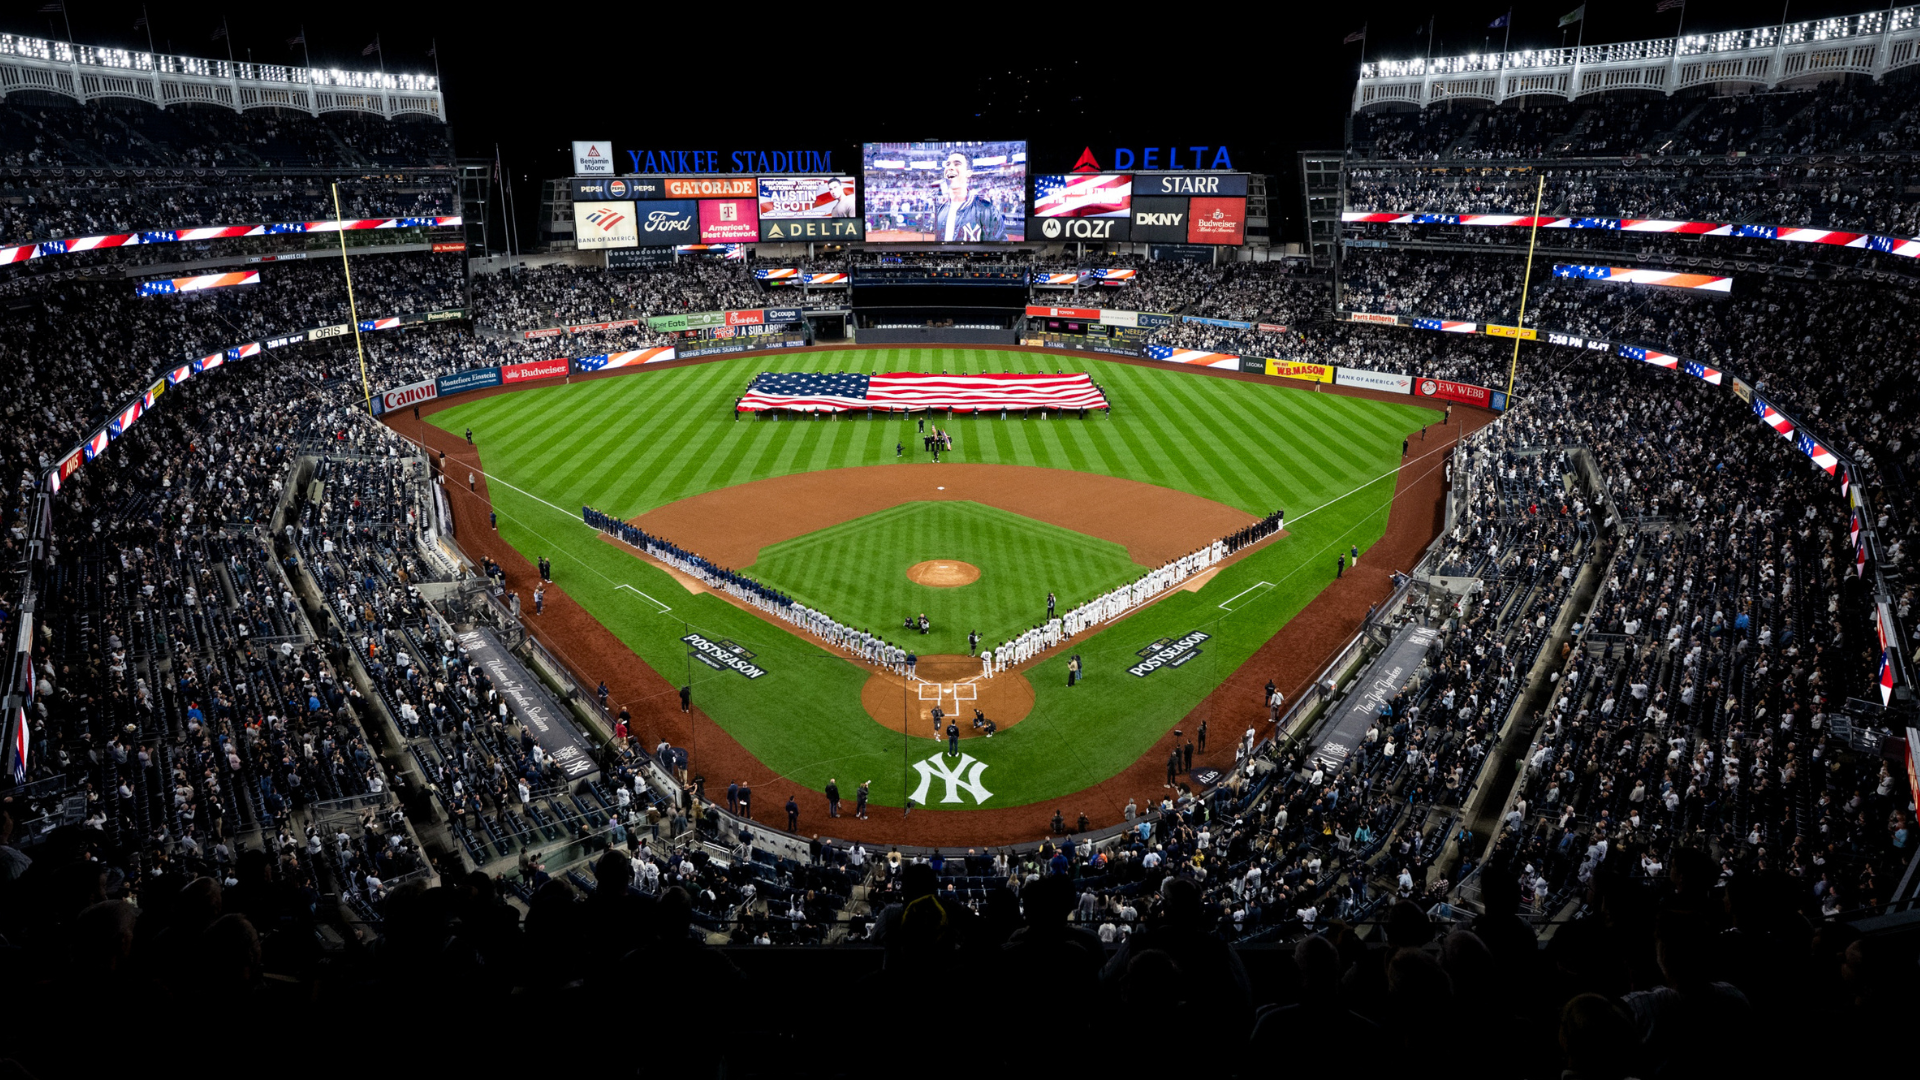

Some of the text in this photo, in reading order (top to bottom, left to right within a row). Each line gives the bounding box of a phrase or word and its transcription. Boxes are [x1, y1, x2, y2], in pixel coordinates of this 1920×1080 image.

[580, 158, 610, 166] Benjamin
[627, 150, 832, 174] YANKEE STADIUM
[1114, 146, 1232, 170] DELTA
[670, 181, 752, 195] GATORADE
[1162, 176, 1219, 193] STARR
[771, 191, 817, 201] AUSTIN
[774, 201, 815, 211] SCOTT
[644, 210, 692, 232] Ford
[1136, 213, 1182, 226] DKNY
[1198, 219, 1236, 228] Budweiser
[790, 222, 857, 236] DELTA
[1066, 220, 1114, 238] razr
[1369, 314, 1395, 323] Authority
[316, 326, 340, 338] ORIS
[742, 326, 747, 336] A
[748, 324, 763, 335] SUB
[1549, 334, 1568, 345] 7:58
[1568, 337, 1583, 348] PM
[521, 364, 566, 378] Budweiser
[440, 376, 471, 387] Montefiore
[472, 372, 496, 381] Einstein
[1366, 377, 1394, 386] AMERICA
[385, 384, 435, 408] Canon
[1438, 382, 1455, 393] F.W.
[1458, 385, 1484, 399] WEBB
[66, 453, 79, 477] AVIS
[683, 634, 764, 678] POSTSEASON
[1129, 632, 1209, 677] POSTSEASON
[486, 658, 509, 682] Welcome
[500, 684, 530, 707] Yankee
[525, 706, 549, 732] Stadium
[1354, 695, 1376, 714] New
[1375, 666, 1403, 691] Yankees
[908, 752, 994, 805] NY
[1200, 770, 1218, 784] ALDS
